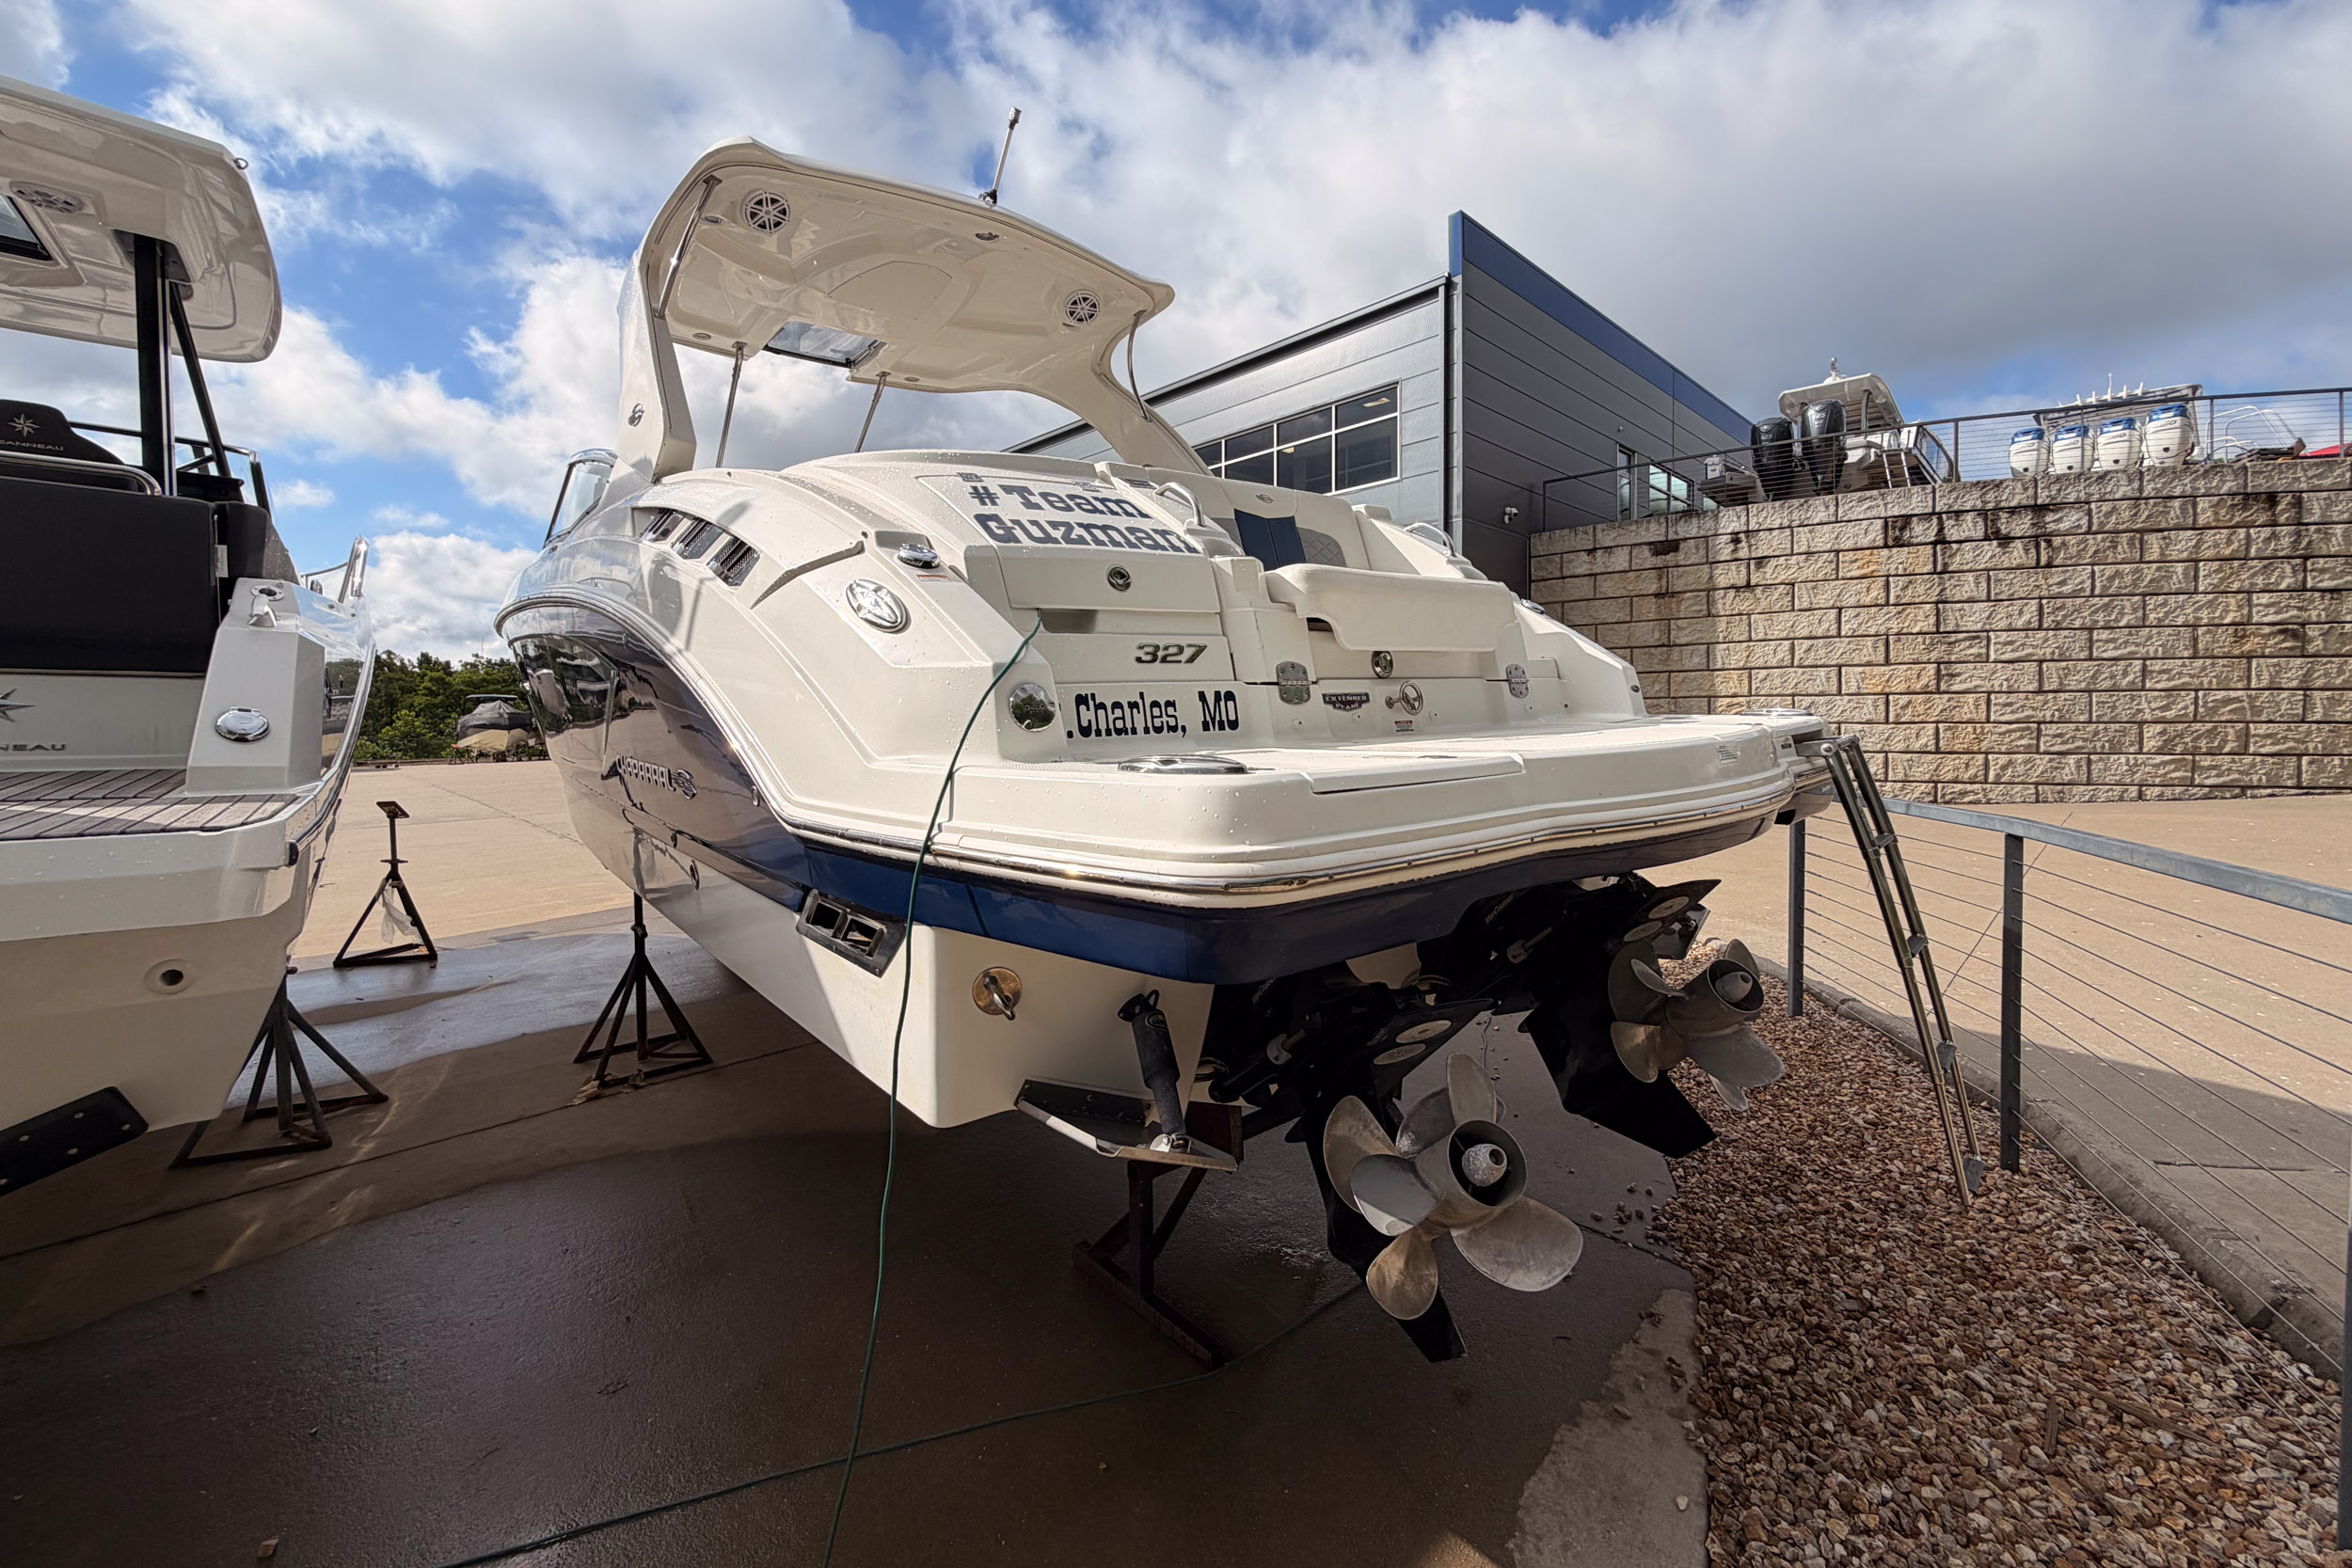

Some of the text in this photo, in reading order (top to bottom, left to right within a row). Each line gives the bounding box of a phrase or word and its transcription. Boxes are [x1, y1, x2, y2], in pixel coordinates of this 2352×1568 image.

[968, 484, 1154, 519] #Team
[973, 514, 1203, 555] Guzman
[1135, 642, 1208, 664] 327
[1074, 691, 1187, 738] Charles,
[1198, 689, 1240, 732] MO
[616, 754, 676, 792] CHAPARRAL
